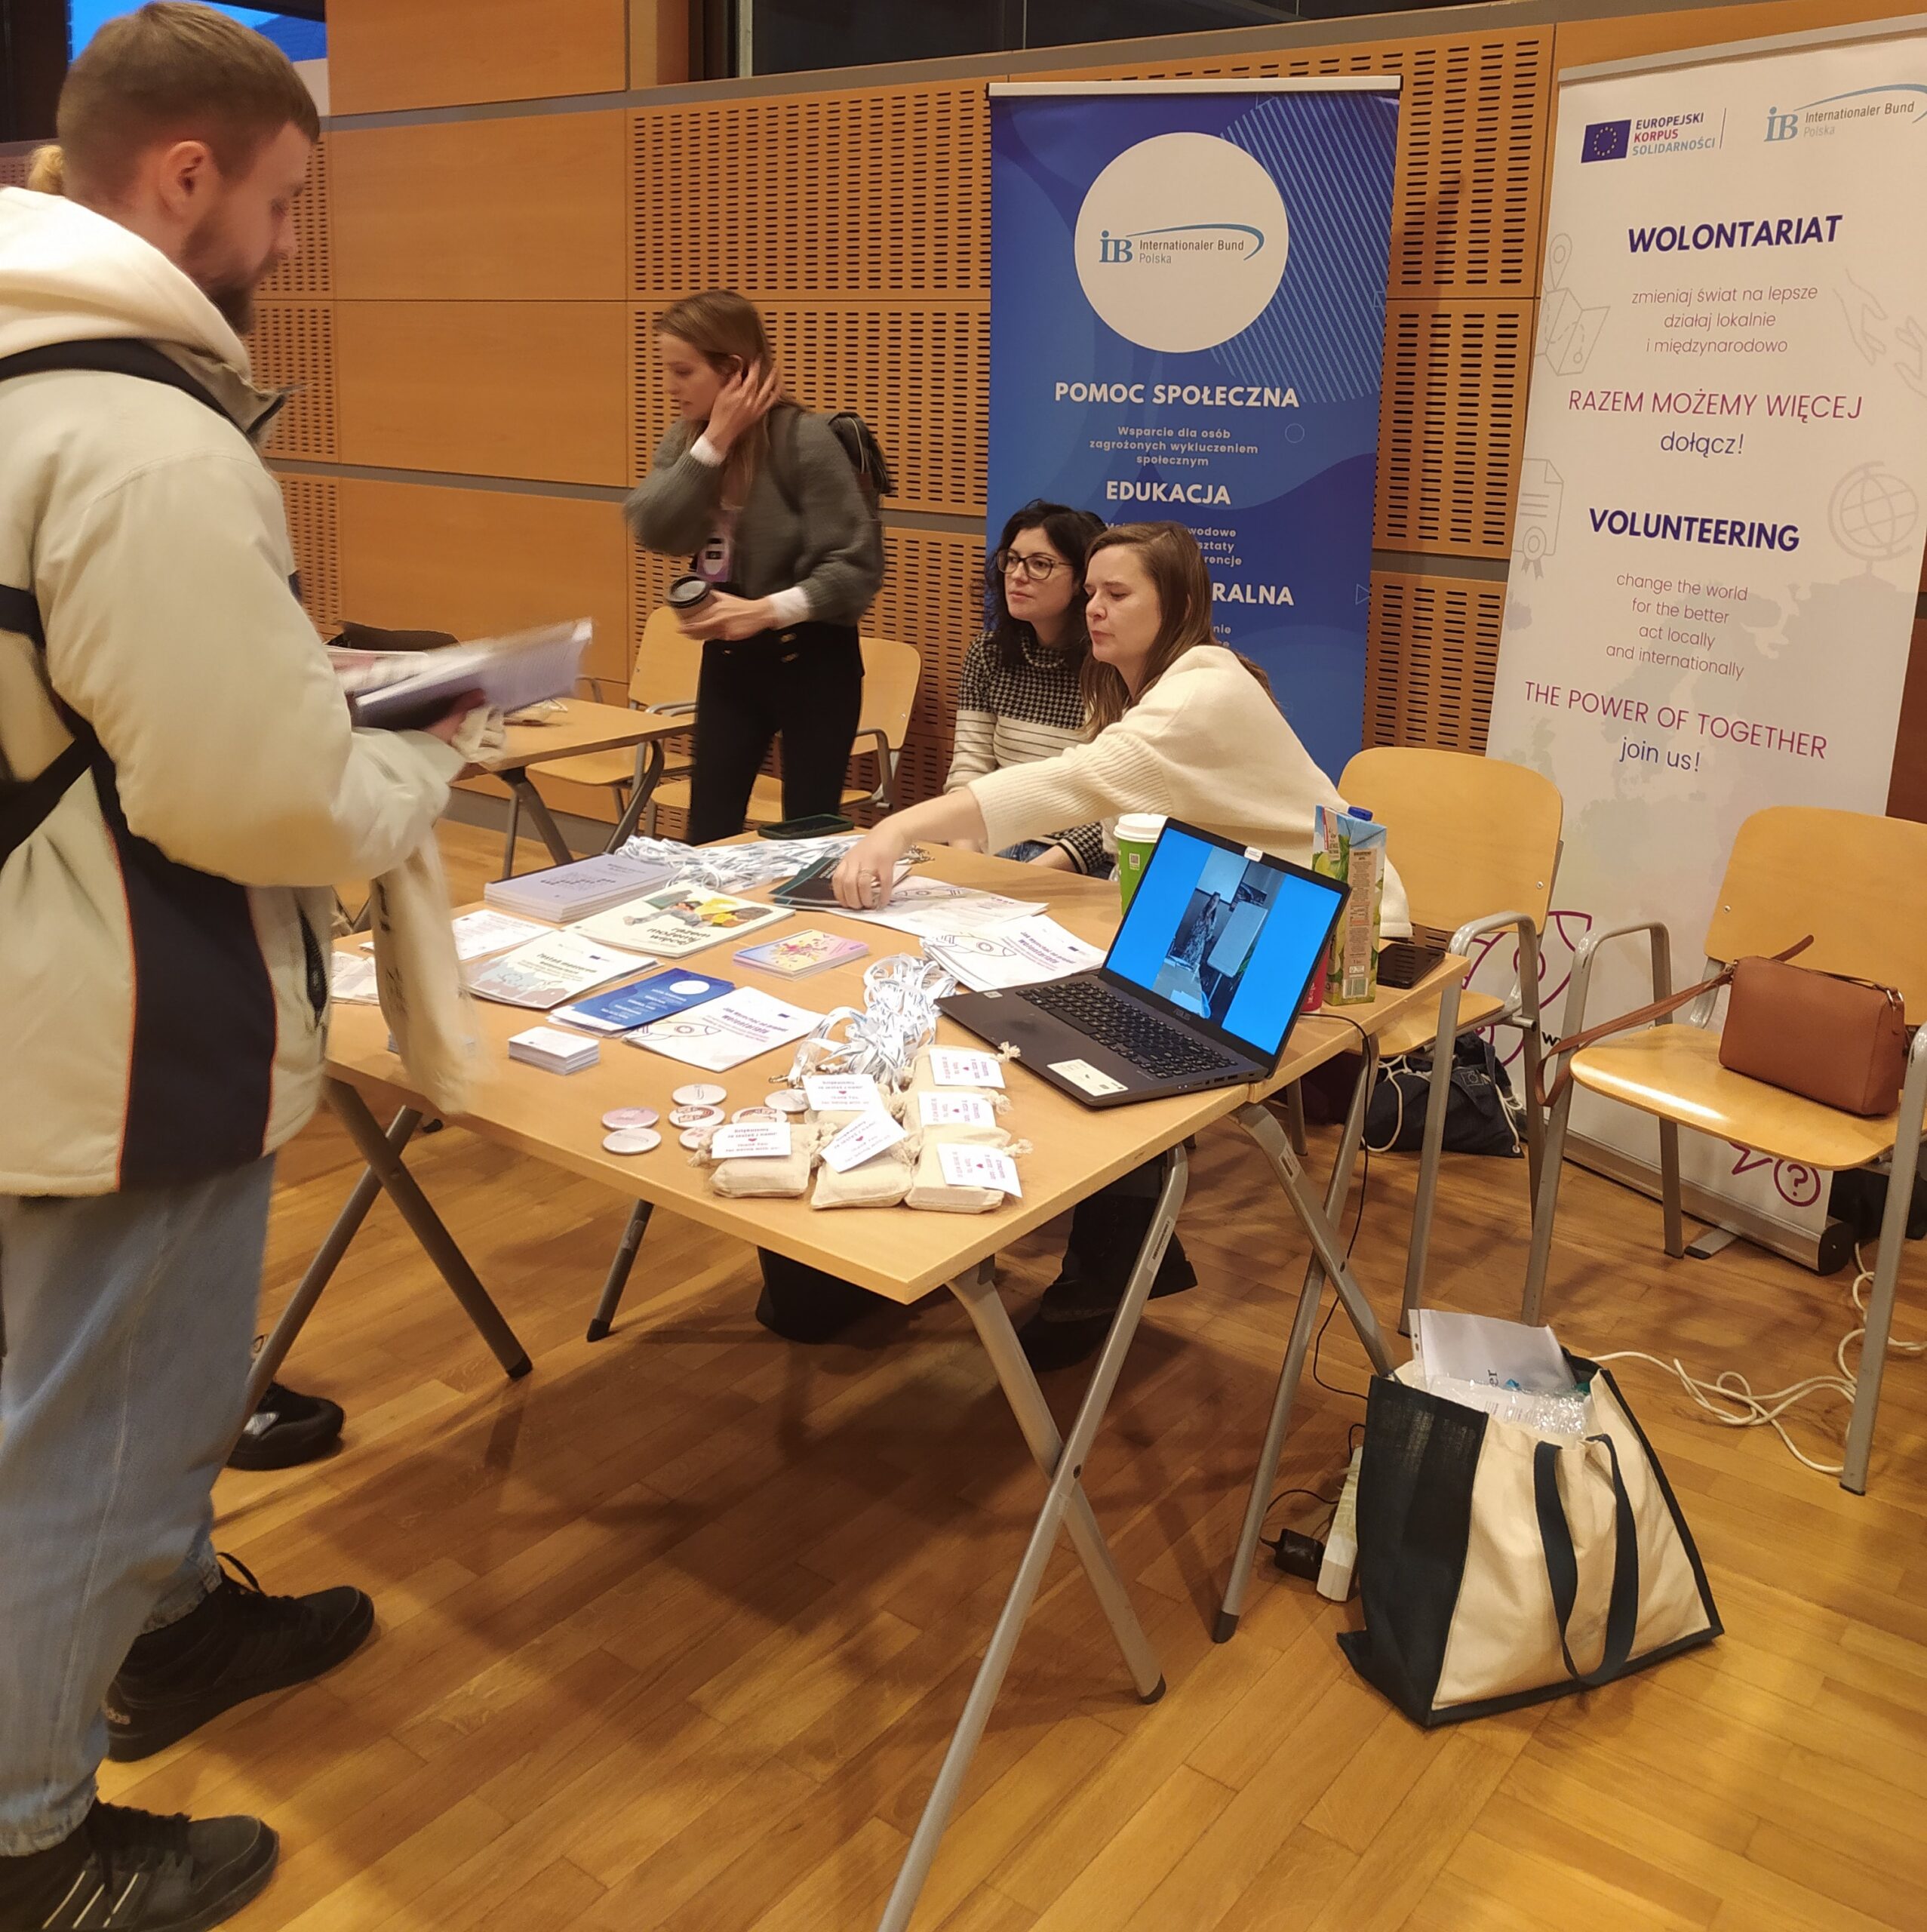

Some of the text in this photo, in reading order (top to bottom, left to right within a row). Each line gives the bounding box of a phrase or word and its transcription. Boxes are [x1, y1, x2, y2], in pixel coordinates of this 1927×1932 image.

[1635, 112, 1704, 131] EUROPEJSKI
[1804, 104, 1880, 123] Internationaler
[1883, 101, 1915, 115] Bund
[1633, 129, 1679, 143] KORPUS
[1803, 125, 1836, 138] Polska
[1632, 136, 1716, 156] SOLIDARNOŚCI
[1627, 214, 1843, 254] WOLONTARIAT
[1139, 239, 1215, 251] Internationaler
[1217, 239, 1245, 251] Bund
[1139, 253, 1172, 264] Polska
[1631, 286, 1818, 306] zmieniaj świat na lepsze
[1664, 312, 1777, 332] działaj lokalnie
[1646, 338, 1788, 358] i międzynarodowo
[1055, 382, 1299, 408] POMOC SPOŁECZNA
[1569, 388, 1864, 423] RAZEM MOŻEMY WIĘCEJ
[1117, 426, 1231, 440] Wsparcie dla osób
[1089, 439, 1259, 454] zagrożonych wykluczeniem
[1660, 430, 1744, 458] dołącz!
[1136, 454, 1209, 468] społecznym
[1105, 481, 1232, 506] EDUKACJA
[1188, 527, 1237, 538] wodowe
[1588, 507, 1800, 552] VOLUNTEERING
[1198, 541, 1235, 554] sztaty
[1203, 555, 1243, 568] rencje
[1212, 583, 1295, 606] RALNA
[1615, 572, 1748, 601] change the world
[1631, 598, 1730, 624] for the better
[1638, 624, 1716, 651] act locally
[1606, 644, 1745, 681] and internationally
[1524, 681, 1828, 760] THE POWER OF TOGETHER
[1618, 737, 1702, 772] join us!
